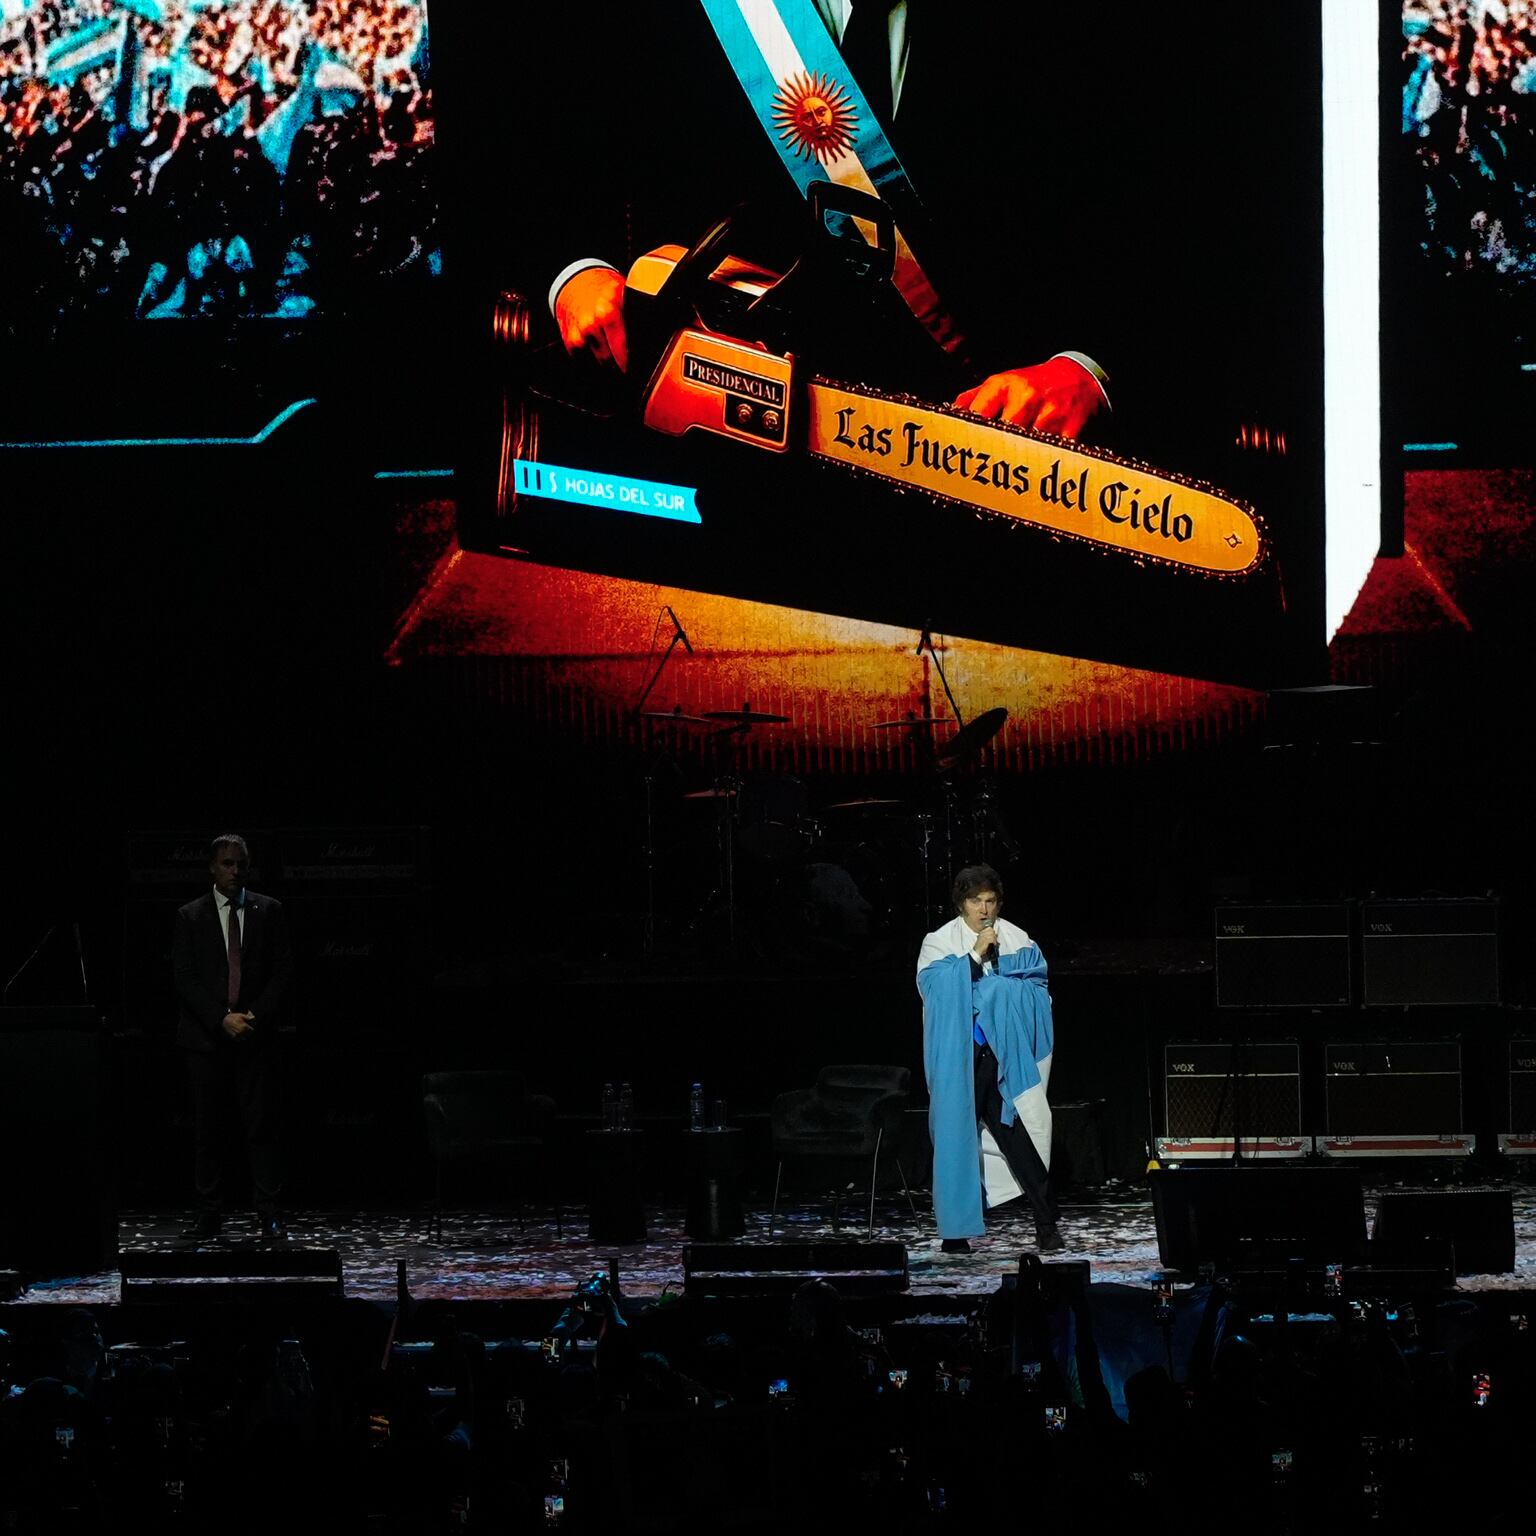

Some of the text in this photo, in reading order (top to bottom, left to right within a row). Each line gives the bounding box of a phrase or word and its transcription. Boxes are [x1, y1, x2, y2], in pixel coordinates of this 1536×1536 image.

[688, 359, 780, 402] PRESIDENCIAL
[833, 407, 1194, 543] Las Fuerzas del Cielo
[565, 477, 685, 512] HOJAS DEL SUR
[1370, 922, 1393, 933] VOX
[1172, 1062, 1195, 1072] VOX
[1333, 1060, 1356, 1071] VOX
